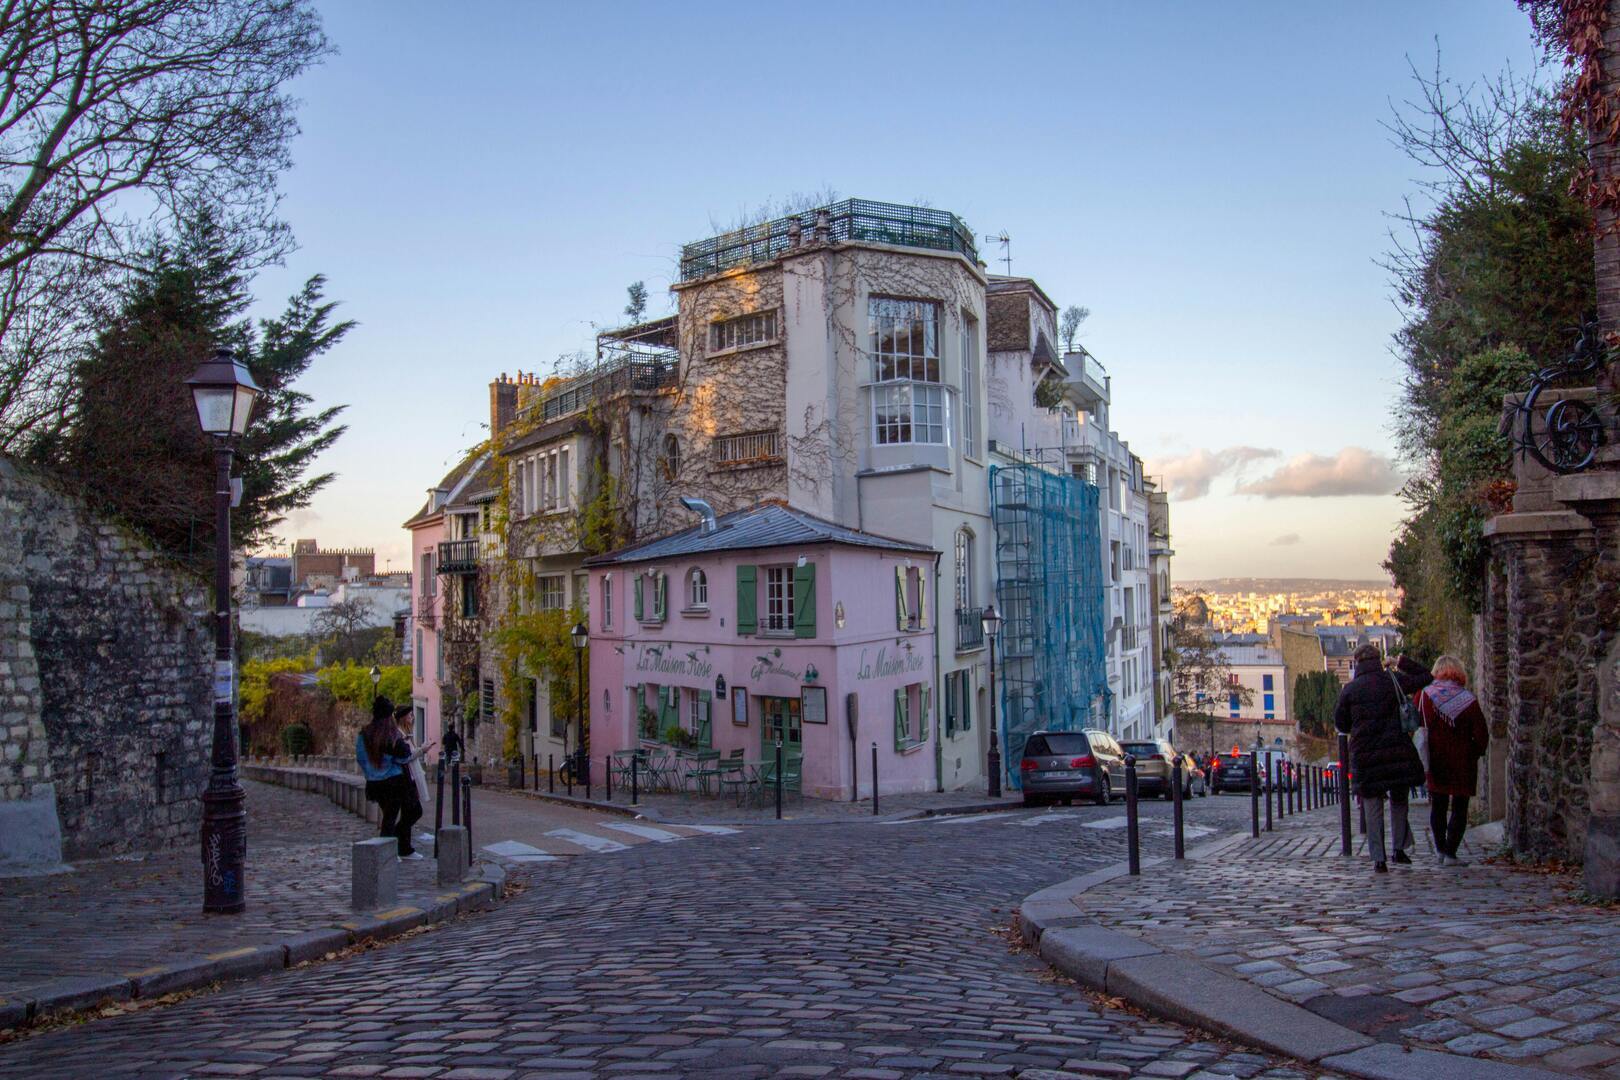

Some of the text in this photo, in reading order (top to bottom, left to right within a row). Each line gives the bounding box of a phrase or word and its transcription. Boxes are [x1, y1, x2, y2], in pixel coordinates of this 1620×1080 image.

[637, 645, 713, 678] La Maison Rose
[857, 646, 924, 680] La Maison Rose
